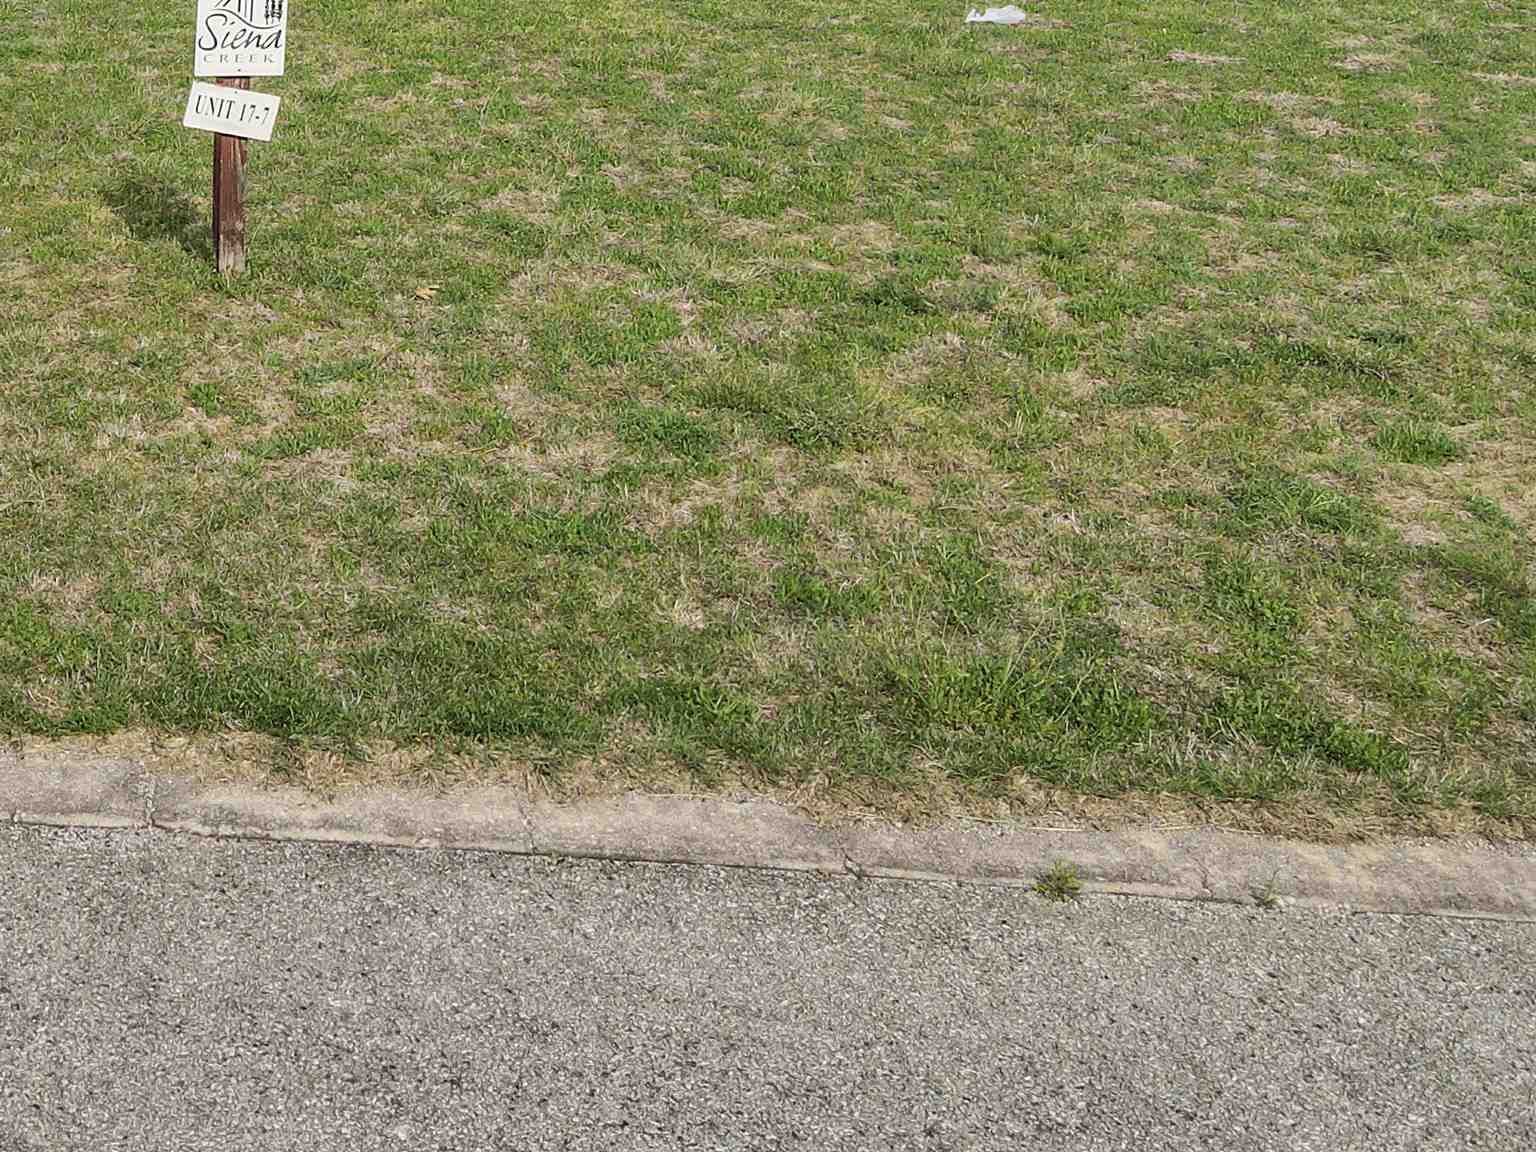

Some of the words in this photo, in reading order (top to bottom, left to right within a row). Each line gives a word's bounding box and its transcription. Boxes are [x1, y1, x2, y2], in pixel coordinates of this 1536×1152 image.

[198, 13, 282, 51] Siena
[203, 53, 276, 64] CREEK
[195, 94, 235, 120] UNIT
[239, 103, 270, 128] 17-7
